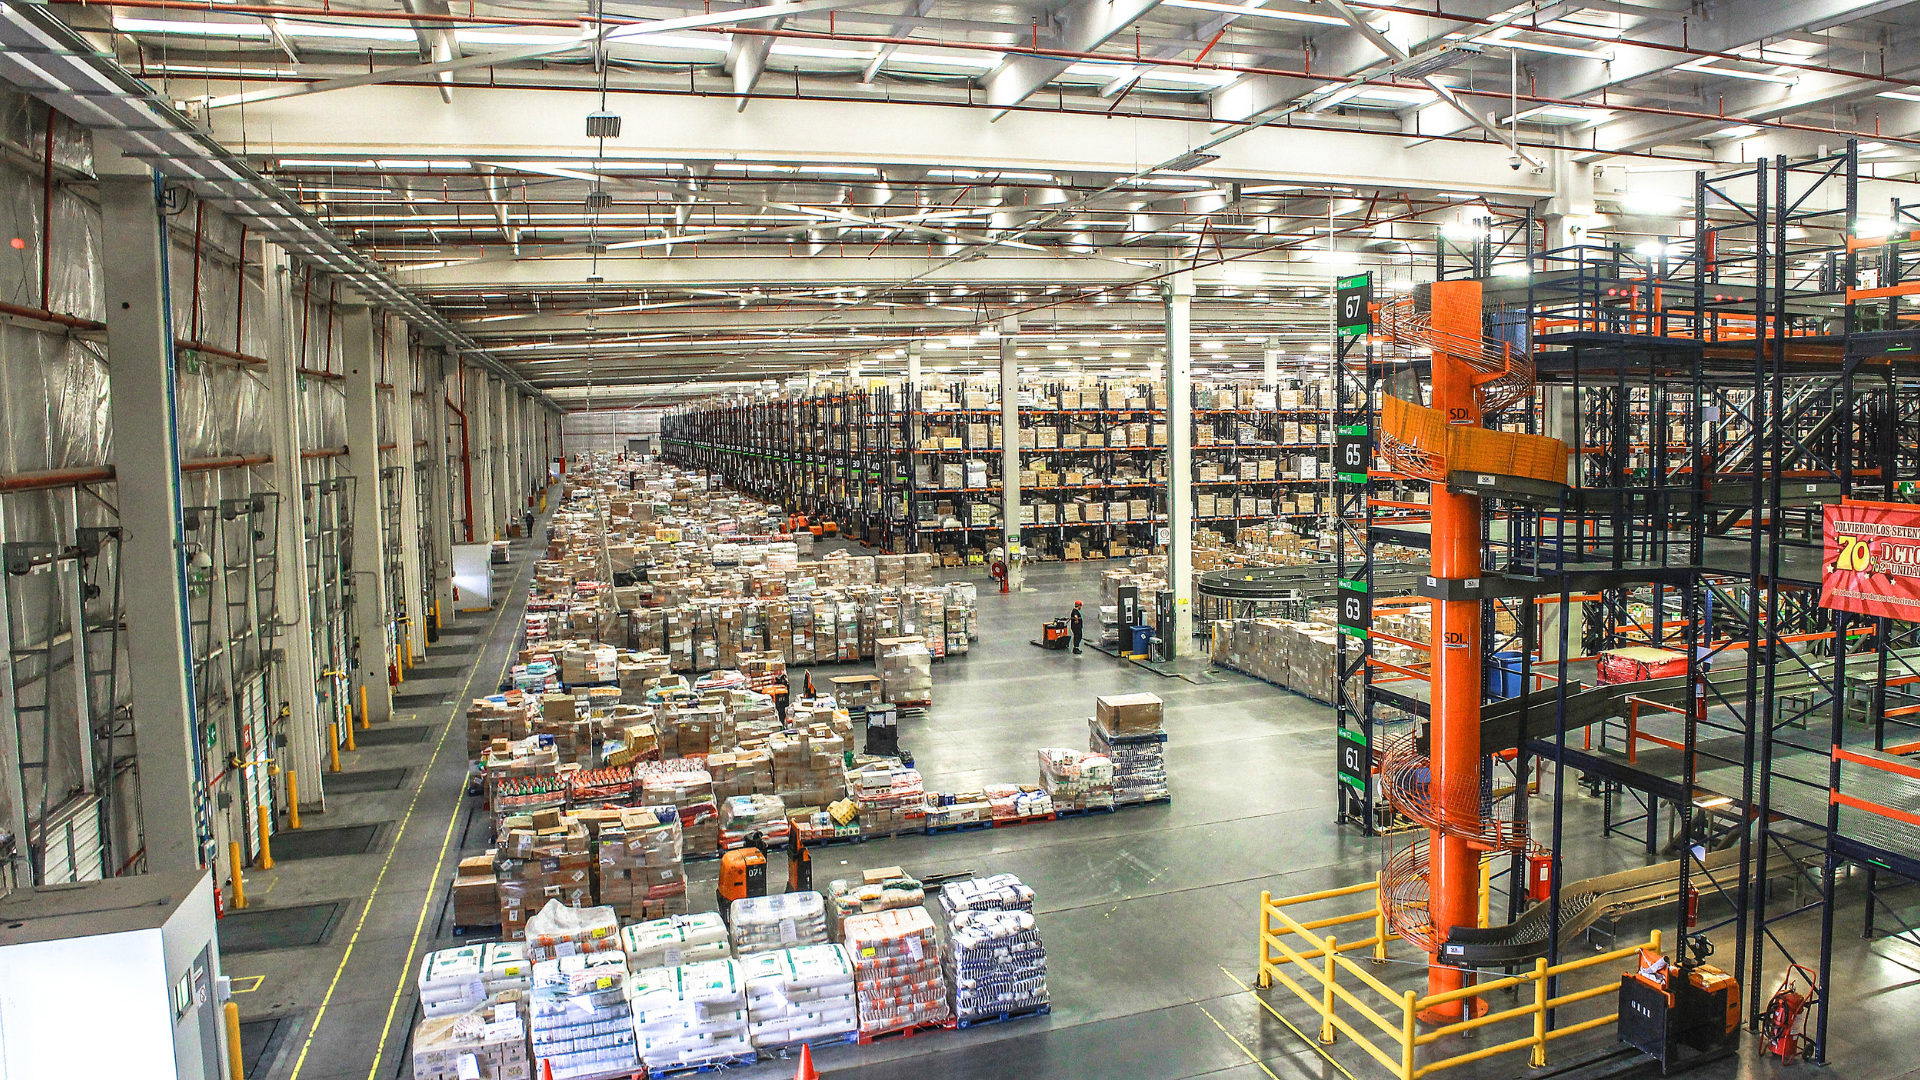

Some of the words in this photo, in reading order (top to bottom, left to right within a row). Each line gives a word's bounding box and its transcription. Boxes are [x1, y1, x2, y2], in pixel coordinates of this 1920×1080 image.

[1345, 295, 1361, 318] 67
[1450, 408, 1469, 420] SDI
[1346, 443, 1361, 466] 65
[852, 460, 860, 468] 39
[871, 462, 880, 471] 40
[897, 466, 906, 474] 41
[1834, 521, 1875, 534] VOLVIERON
[1876, 525, 1890, 536] LOS
[1861, 592, 1886, 602] productos
[1346, 597, 1360, 620] 63
[1444, 632, 1463, 643] SDI
[1346, 747, 1360, 771] 61
